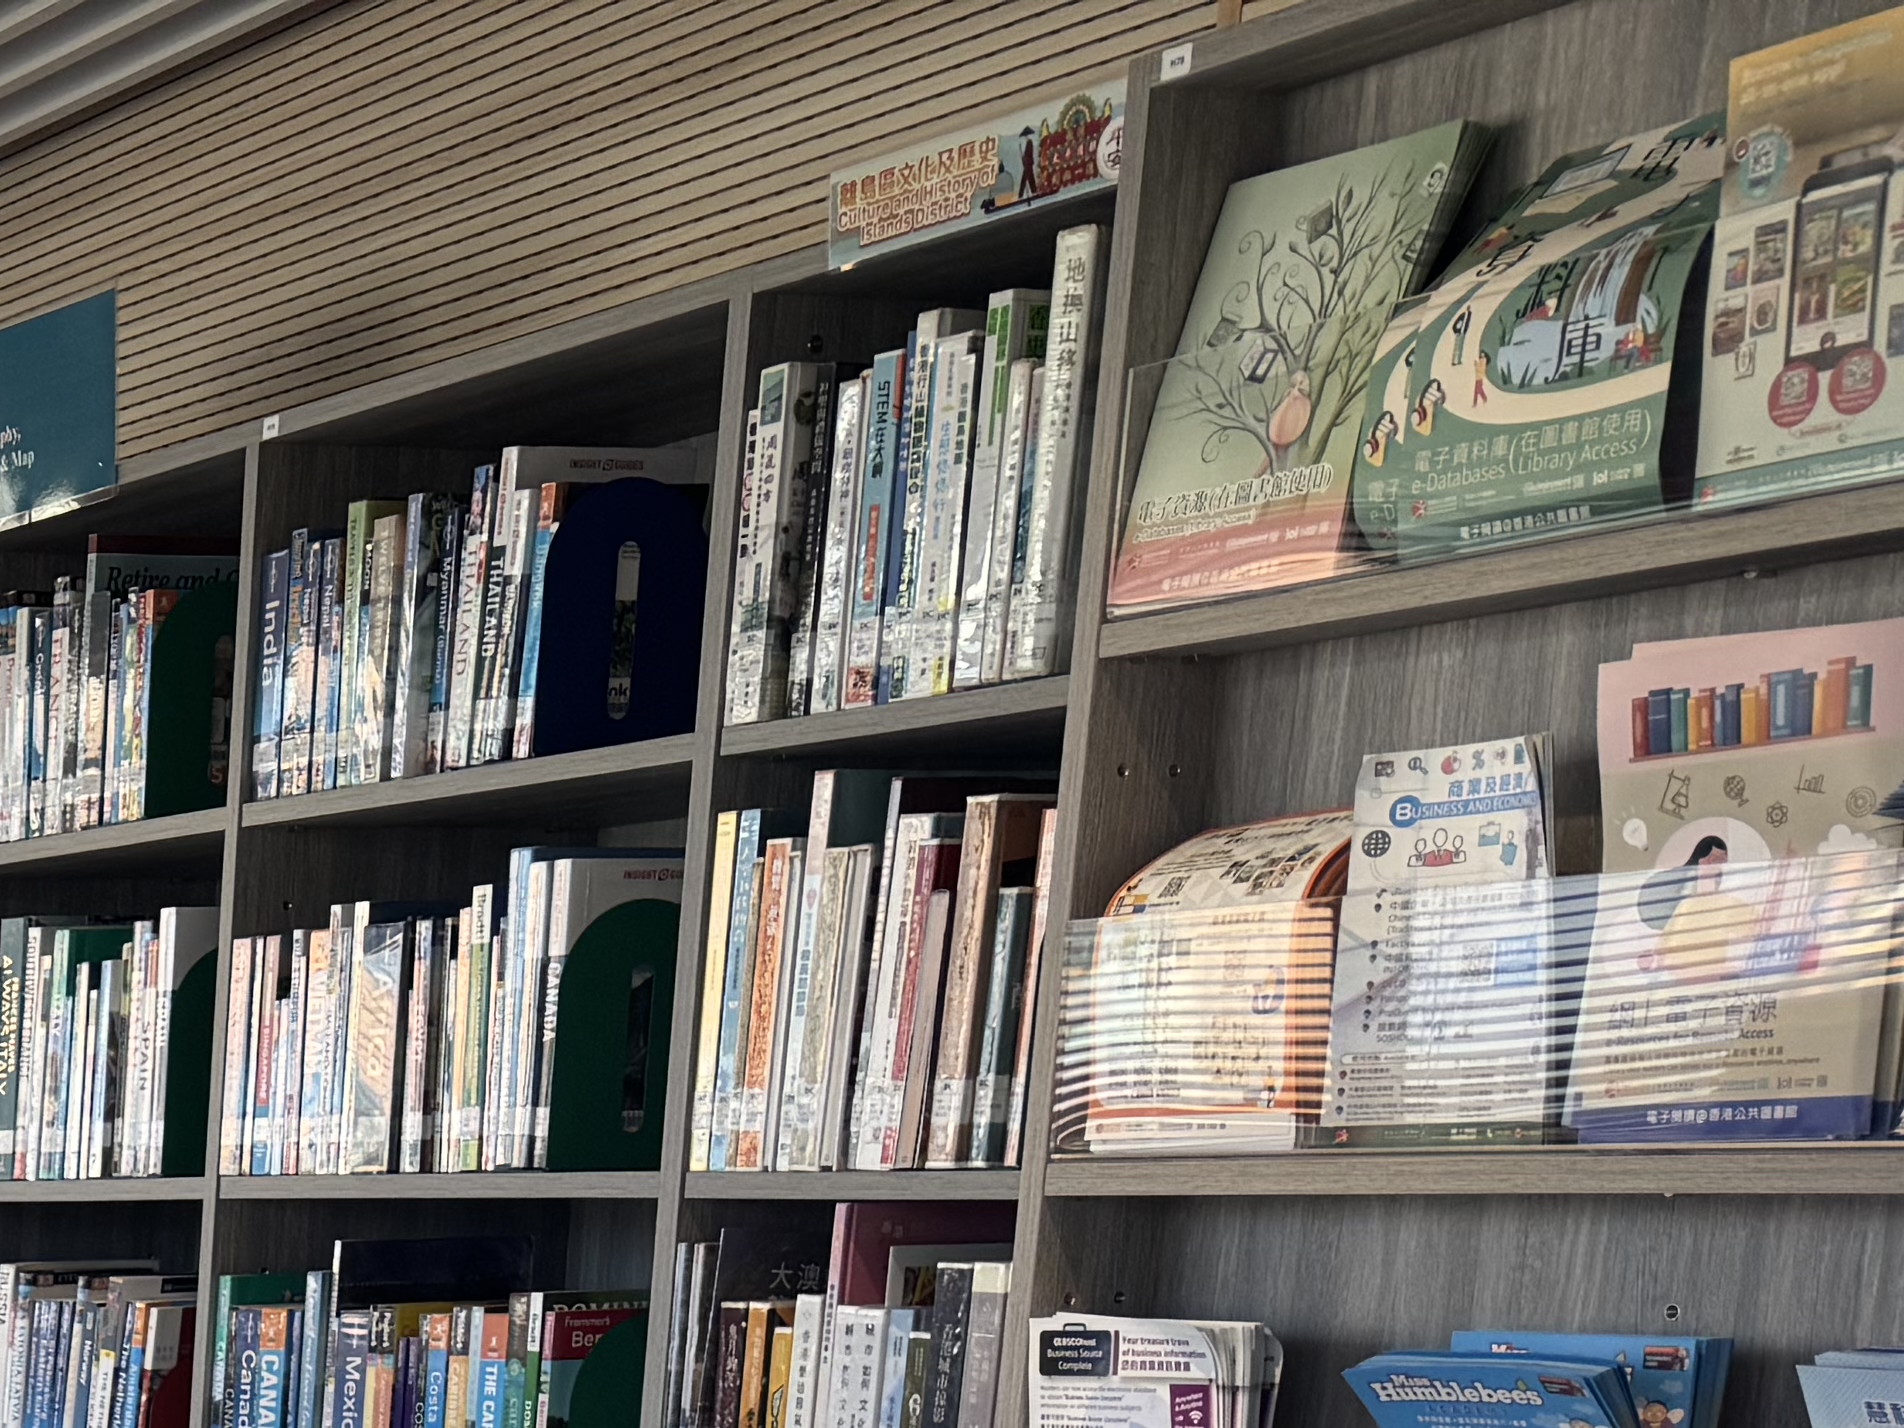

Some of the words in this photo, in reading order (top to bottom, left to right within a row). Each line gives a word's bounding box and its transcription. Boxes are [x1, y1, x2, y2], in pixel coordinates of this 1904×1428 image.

[839, 200, 890, 229] Culture
[893, 190, 920, 211] and
[923, 173, 979, 198] History
[981, 166, 997, 186] of
[840, 136, 998, 208] 離島區文化及歷史
[861, 214, 912, 241] Islands
[916, 198, 971, 226] District
[11, 449, 35, 472] Map
[1412, 464, 1506, 496] e-Databases
[1518, 450, 1577, 476] Library
[1580, 435, 1638, 464] Access
[106, 566, 168, 591] Retire
[439, 556, 452, 628] Myanmar
[481, 556, 504, 657] THAILAND
[455, 547, 477, 677] THAILAND
[262, 600, 280, 688] India
[1395, 799, 1464, 821] BUSINESS
[1467, 797, 1492, 815] AND
[541, 962, 562, 1043] CANADA
[1738, 1027, 1774, 1041] Access
[428, 1371, 442, 1423] Costa
[484, 1364, 498, 1396] THE
